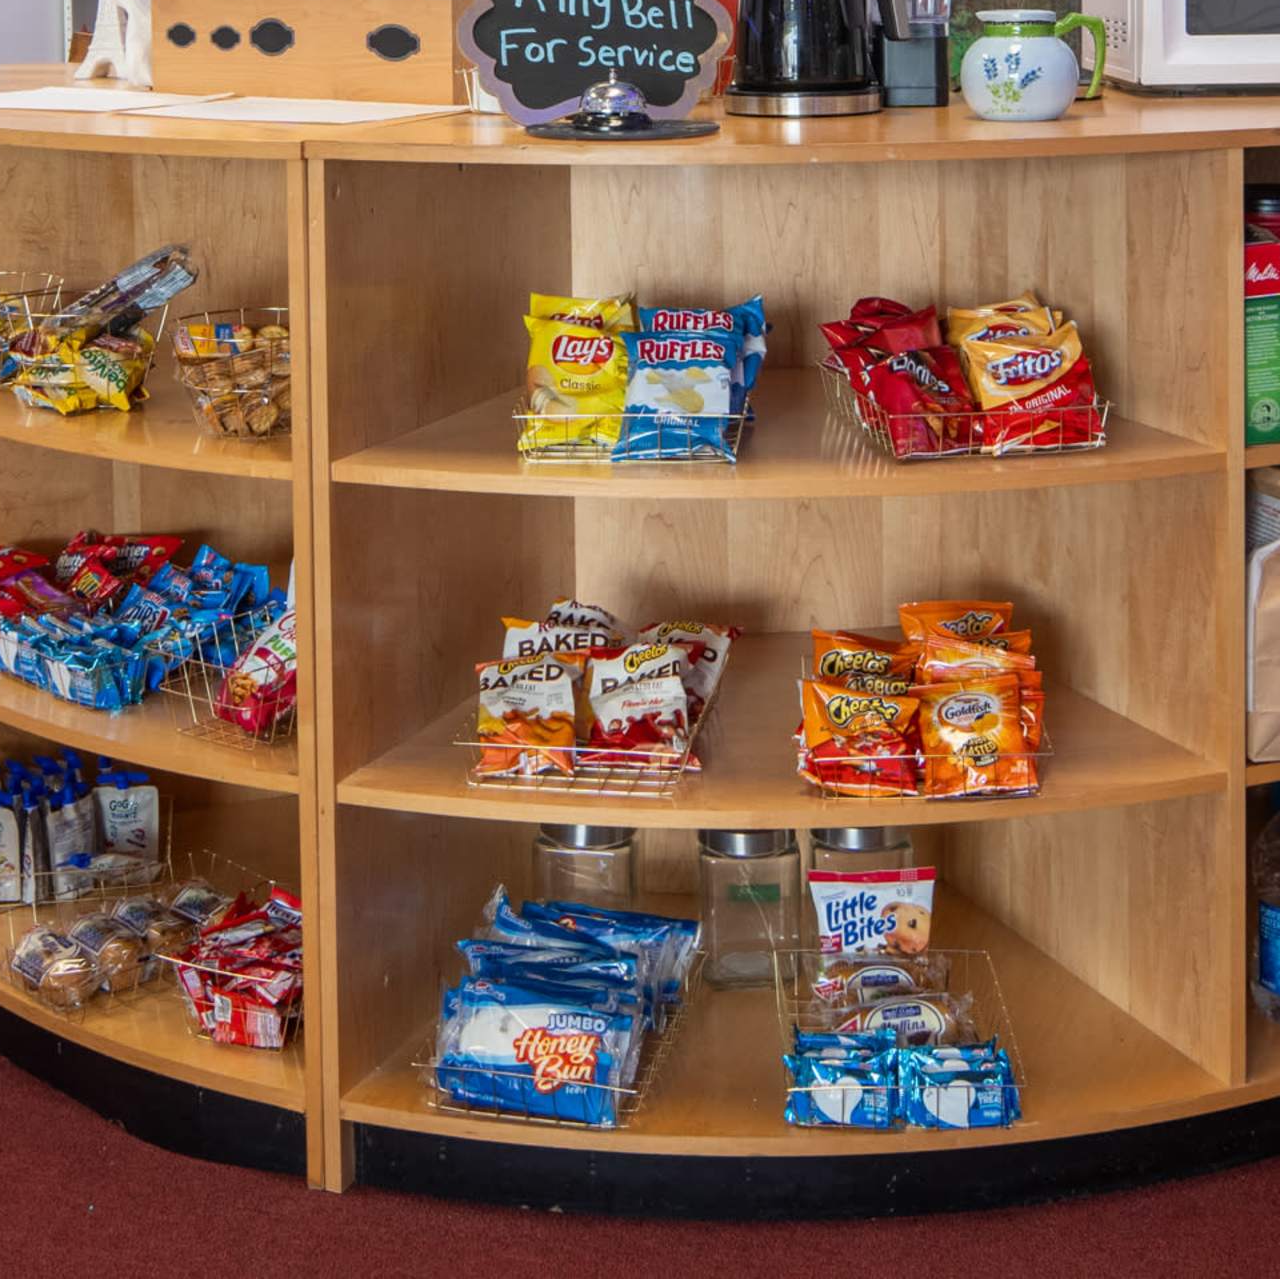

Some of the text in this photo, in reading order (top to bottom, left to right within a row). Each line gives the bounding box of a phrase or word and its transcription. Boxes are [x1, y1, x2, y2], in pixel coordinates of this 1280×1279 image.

[500, 27, 695, 73] For Service
[652, 309, 735, 333] RUFFLES
[637, 339, 726, 365] RUFFLES
[987, 349, 1064, 386] Fritos
[559, 377, 602, 393] Classic
[1025, 385, 1072, 412] ORIGINAL
[518, 632, 609, 657] BAKED
[623, 644, 669, 674] Cheetos
[821, 649, 890, 676] Cheetos
[943, 701, 993, 720] Goldfish
[825, 890, 878, 933] Little
[844, 913, 897, 947] Bites
[548, 1013, 607, 1033] JUMBO
[514, 1029, 596, 1064] Honey
[533, 1053, 592, 1091] Bun
